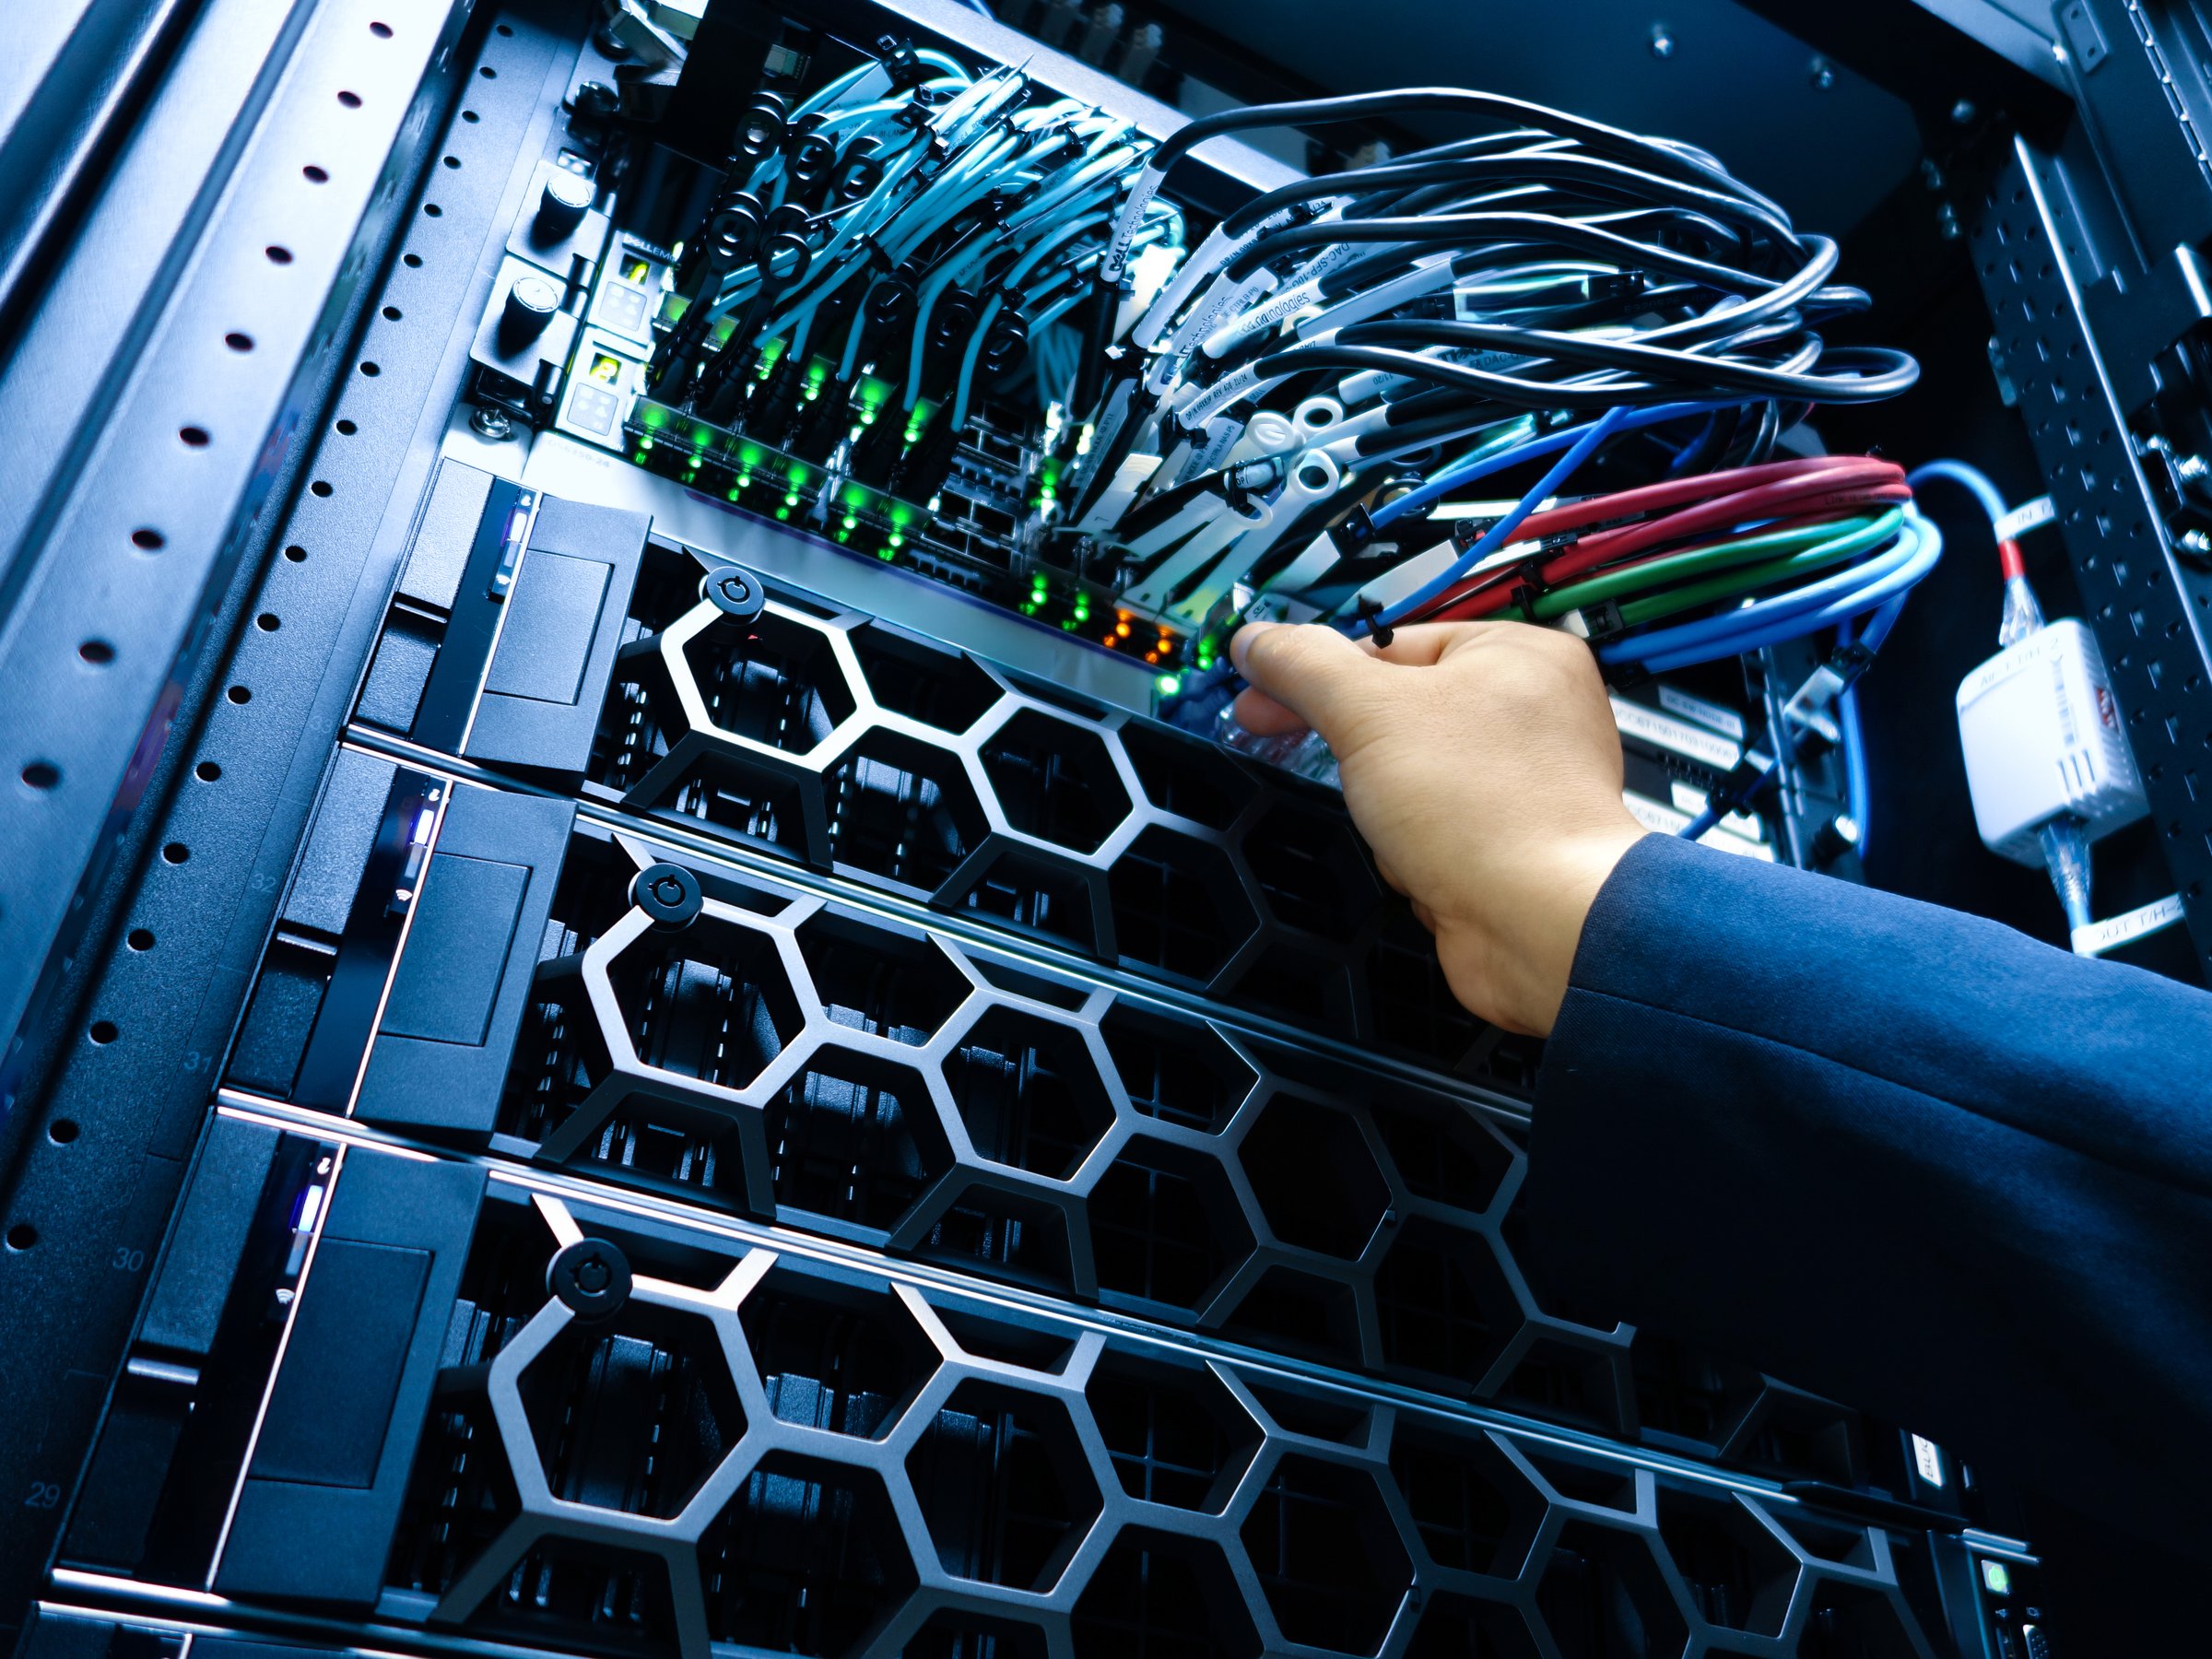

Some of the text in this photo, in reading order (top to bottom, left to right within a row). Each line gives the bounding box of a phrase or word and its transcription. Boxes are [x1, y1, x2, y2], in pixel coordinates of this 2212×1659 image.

[1121, 184, 1157, 241] Technologies
[251, 870, 276, 893] 32
[184, 1051, 212, 1075] 31
[113, 1246, 145, 1272] 30
[25, 1483, 61, 1509] 29
